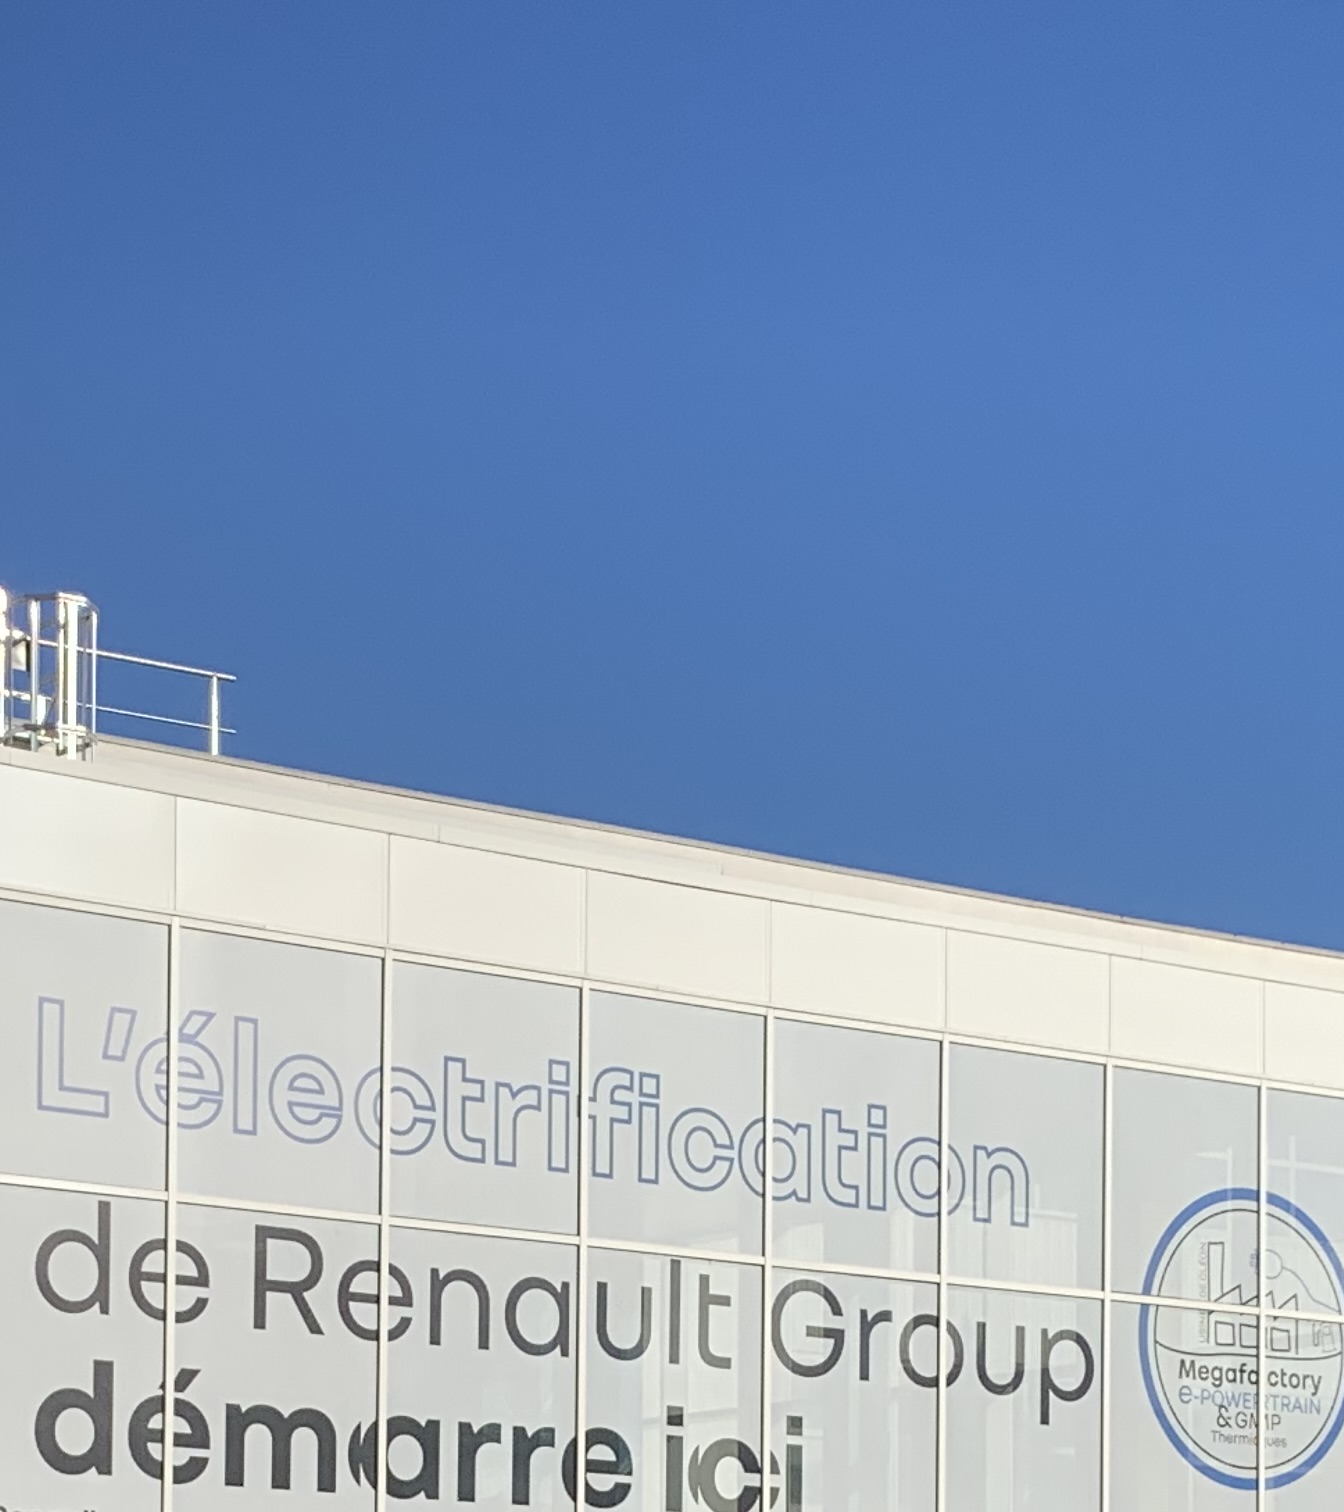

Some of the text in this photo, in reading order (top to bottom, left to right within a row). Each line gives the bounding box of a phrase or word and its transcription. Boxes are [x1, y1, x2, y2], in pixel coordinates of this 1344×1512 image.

[37, 996, 1030, 1228] L'électrification
[34, 1199, 1095, 1426] de Renault Group
[1178, 1358, 1323, 1396] Megafactory
[34, 1359, 633, 1509] démarre
[1216, 1405, 1232, 1428] &
